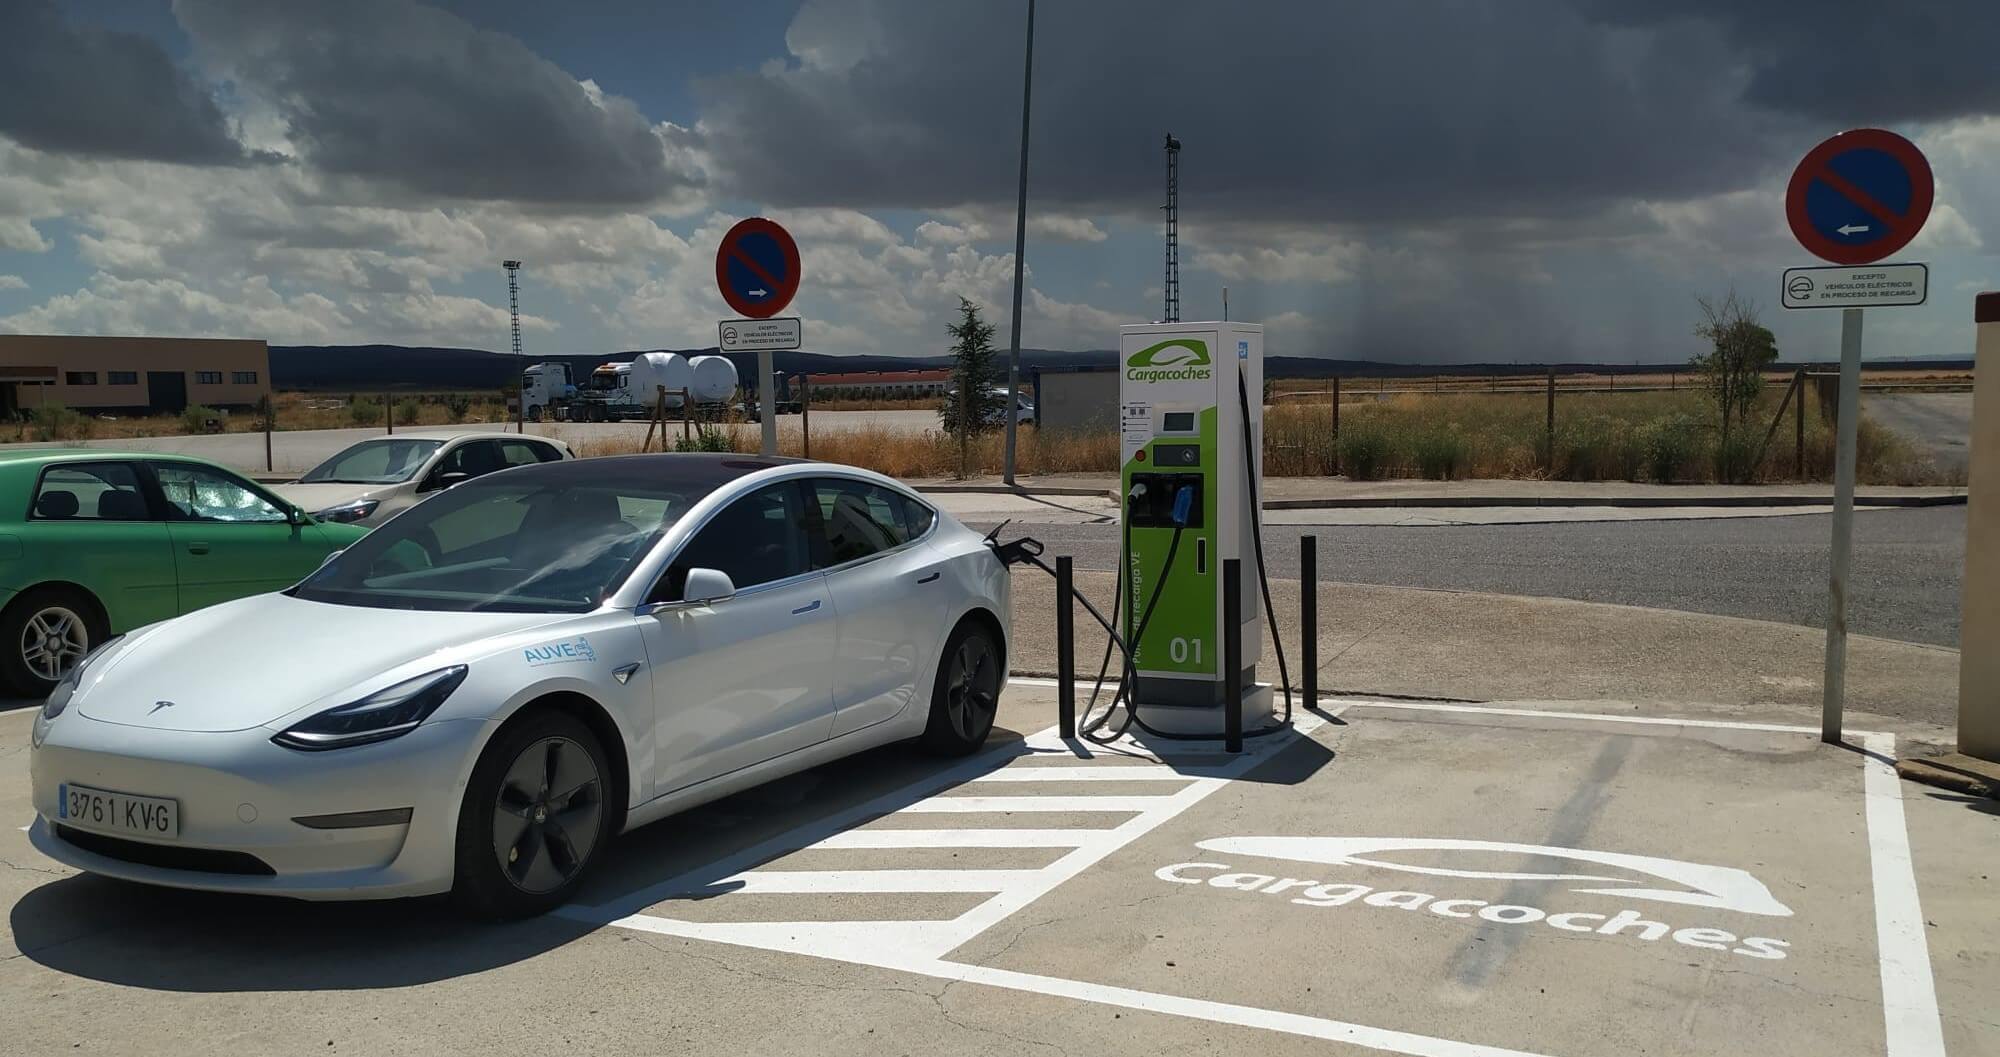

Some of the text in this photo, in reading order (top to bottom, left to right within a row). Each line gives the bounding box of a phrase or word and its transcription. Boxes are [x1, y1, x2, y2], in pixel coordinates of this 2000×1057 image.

[1852, 273, 1886, 281] EXCEPTO
[1832, 291, 1867, 299] PROCESO
[1880, 289, 1917, 297] RECARGA
[1127, 366, 1211, 384] Cargacoches
[1131, 551, 1140, 566] VE
[1132, 568, 1142, 613] recarga
[524, 643, 576, 663] AUVE
[1170, 637, 1202, 665] 01
[70, 791, 114, 825] 3761
[1154, 861, 1791, 960] Cargacoches
